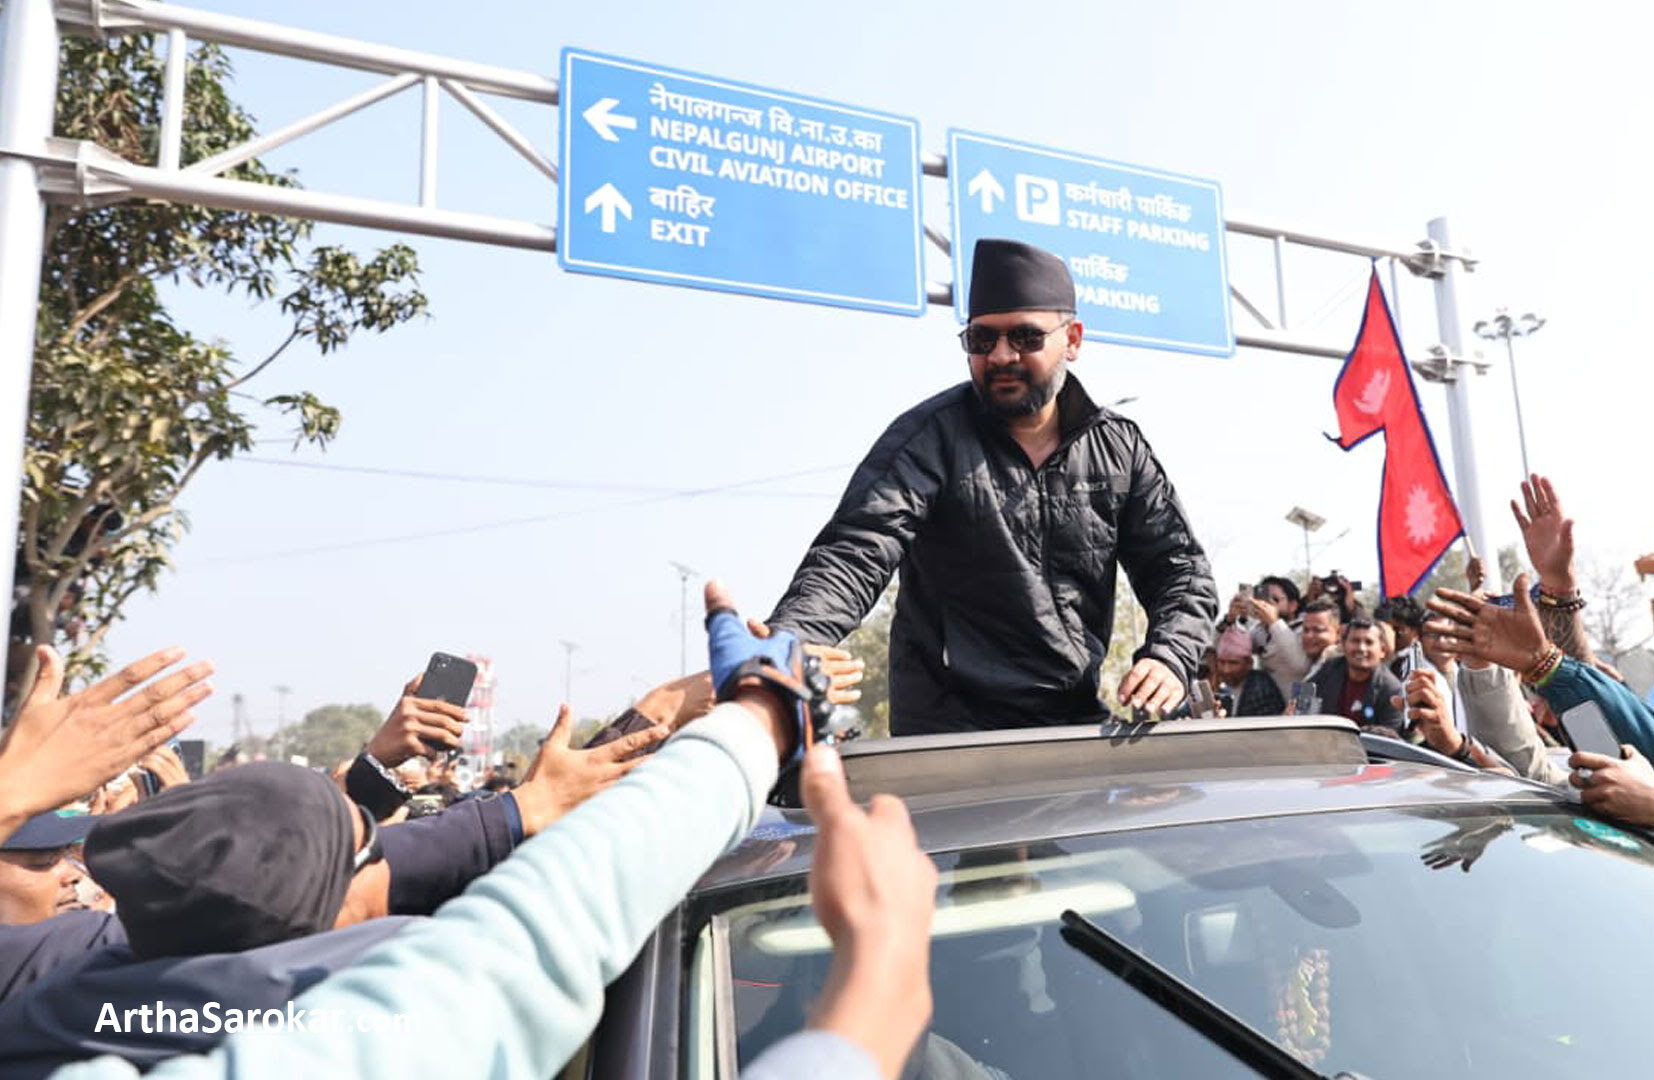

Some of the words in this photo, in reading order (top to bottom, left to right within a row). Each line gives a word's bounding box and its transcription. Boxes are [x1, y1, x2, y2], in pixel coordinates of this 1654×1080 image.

[650, 83, 761, 129] नेपालगन्ज
[769, 108, 882, 153] वि.ना.उ.का
[651, 117, 784, 164] NEPALGUNJ
[791, 145, 884, 179] AIRPORT
[649, 146, 714, 176] CIVIL
[720, 160, 828, 197] AVIATION
[836, 180, 908, 209] OFFICE
[650, 185, 715, 219] बाहिर
[651, 219, 710, 247] EXIT
[1067, 210, 1122, 235] STAFF
[1128, 220, 1209, 251] PARKING
[1075, 284, 1159, 313] PARKING
